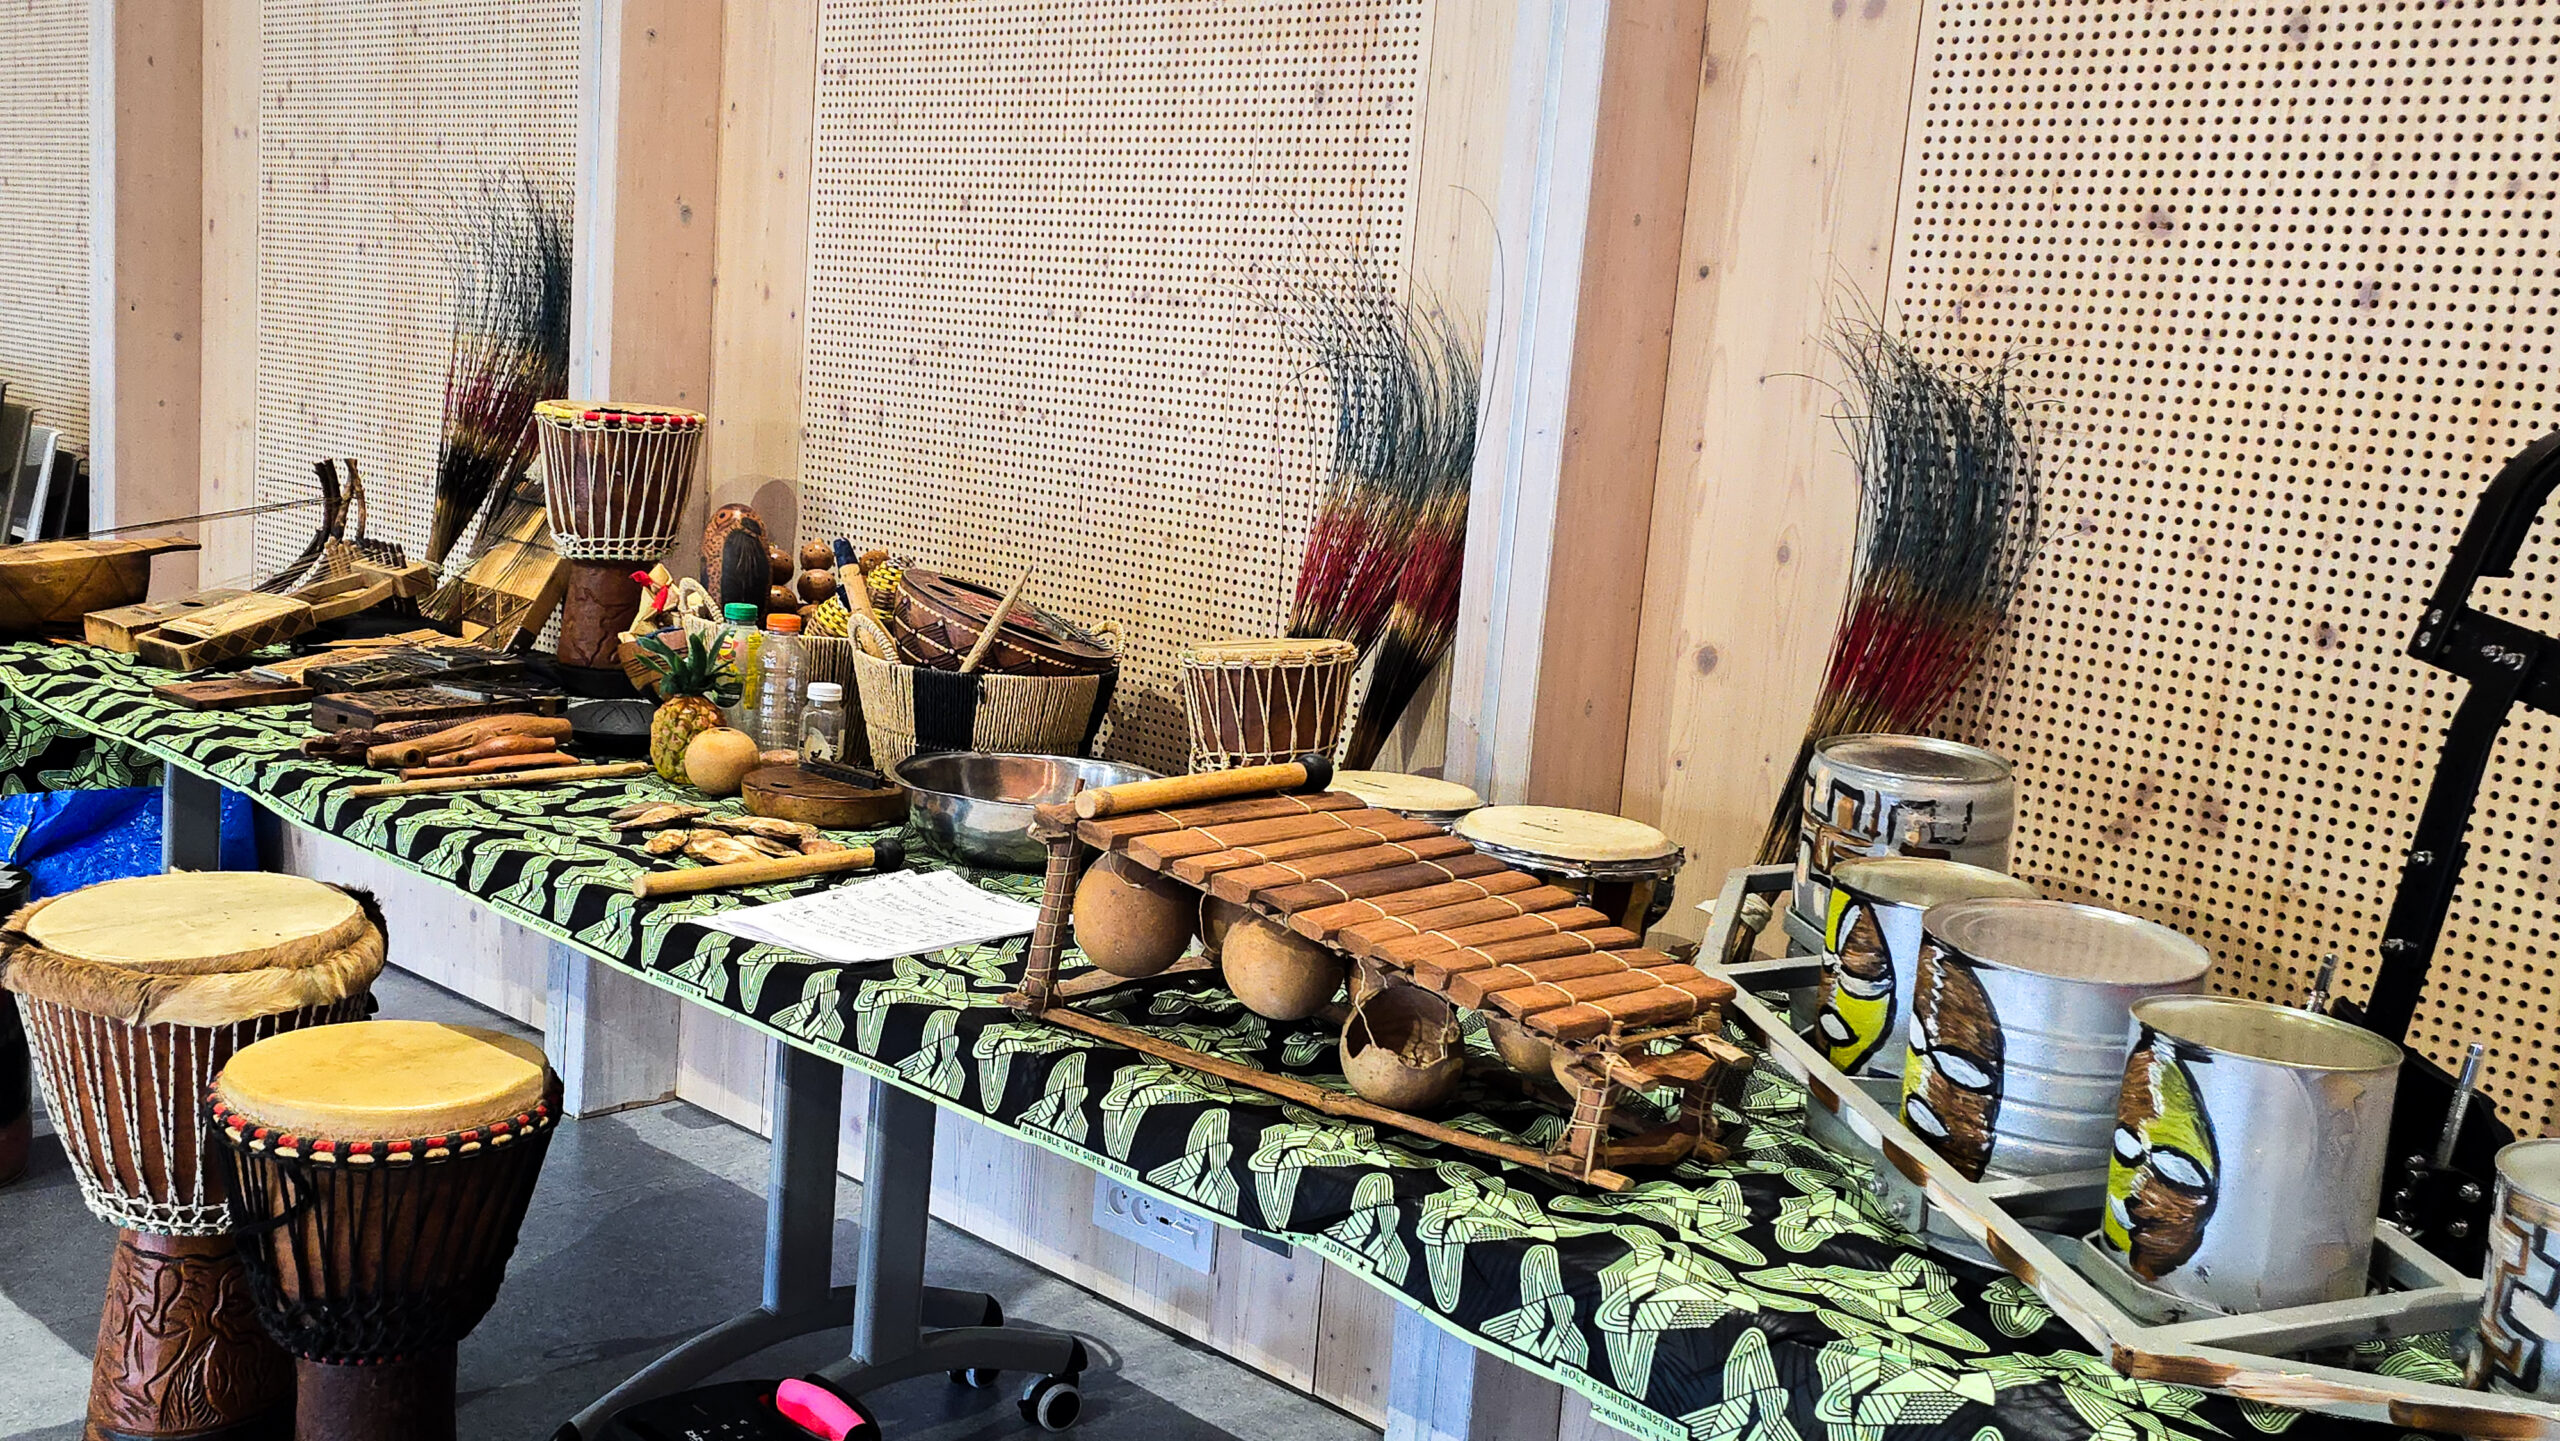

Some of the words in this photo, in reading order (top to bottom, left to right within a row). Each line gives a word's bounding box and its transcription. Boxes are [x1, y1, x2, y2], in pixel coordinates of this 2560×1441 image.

[817, 1041, 836, 1054] HOLY
[1064, 1140, 1080, 1156] WAX
[1083, 1151, 1106, 1168] SUPER
[1110, 1163, 1133, 1180] ADIVA
[1323, 1241, 1353, 1263] ADIVA
[1561, 1366, 1587, 1387] HOLY
